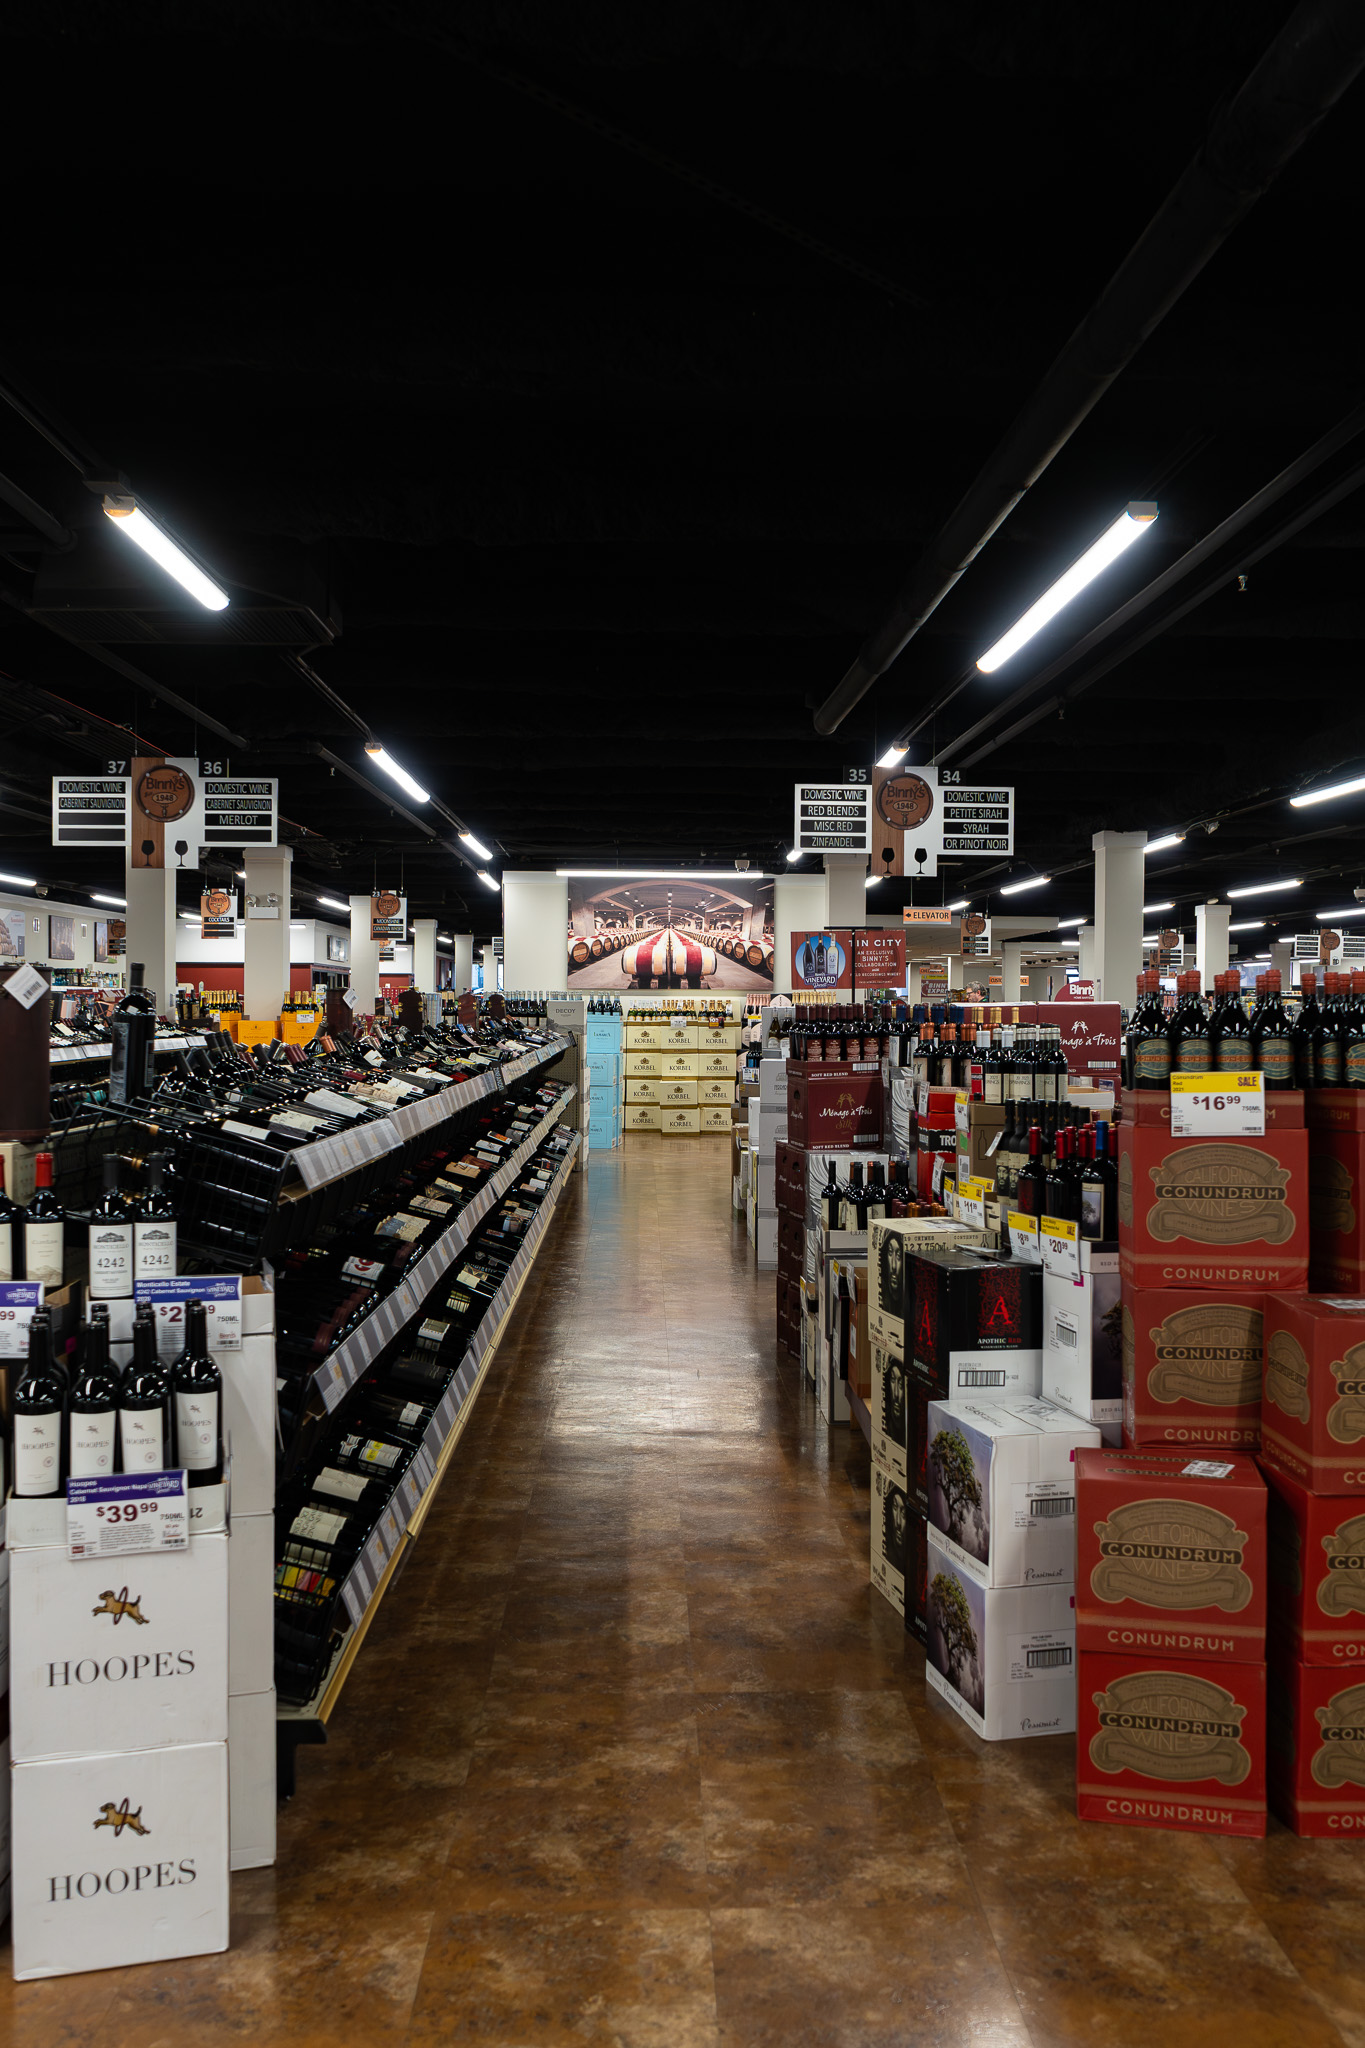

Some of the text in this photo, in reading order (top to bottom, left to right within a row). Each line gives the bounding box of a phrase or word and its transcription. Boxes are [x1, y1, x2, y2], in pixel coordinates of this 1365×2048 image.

[108, 762, 126, 774] 37
[204, 762, 222, 774] 36
[849, 770, 866, 782] 35
[943, 771, 960, 783] 34
[62, 782, 123, 792] DOMESTIC WINE
[208, 784, 269, 794] DOMESTIC WINE
[156, 794, 174, 802] 1948
[804, 790, 863, 800] DOMESTIC WINE
[947, 792, 1006, 802] DOMESTIC WINE
[60, 798, 124, 809] CABERNET SAUVIGNON
[206, 800, 271, 810] CABERNET SAUVIGNON
[808, 806, 859, 816] RED BLENDS
[950, 809, 1003, 818] PETITE SIRAH
[219, 816, 258, 825] MERLOT
[814, 821, 853, 831] MISC RED
[962, 824, 989, 833] SYRAH
[812, 837, 854, 847] ZINFANDEL
[946, 840, 1007, 850] OR PINOT NOIR
[874, 939, 902, 947] CITY
[1059, 1036, 1083, 1049] énage
[1093, 1033, 1116, 1046] Trois
[1237, 1076, 1257, 1086] SALE
[856, 1106, 872, 1116] Trois
[835, 1120, 856, 1130] Silk
[1162, 1187, 1279, 1198] CONUNDRUM
[1185, 1201, 1257, 1216] WINES
[97, 1258, 125, 1268] 4242
[142, 1255, 170, 1264] 4242
[1163, 1268, 1279, 1281] CONUNDRUM
[22, 1442, 56, 1450] HOOPES
[76, 1440, 109, 1448] HOOPES
[1108, 1544, 1234, 1562] CONUNDRUM
[1024, 1568, 1064, 1581] Pessimist
[1133, 1559, 1209, 1580] WINES
[1108, 1630, 1234, 1652] CONUNDRUM
[46, 1649, 195, 1688] HOOPES
[1020, 1718, 1061, 1731] Pessimist
[1106, 1714, 1233, 1736] CONUNDRUM
[1131, 1730, 1207, 1750] WINES
[1106, 1800, 1232, 1823] CONUNDRUM
[48, 1858, 197, 1902] HOOPES
